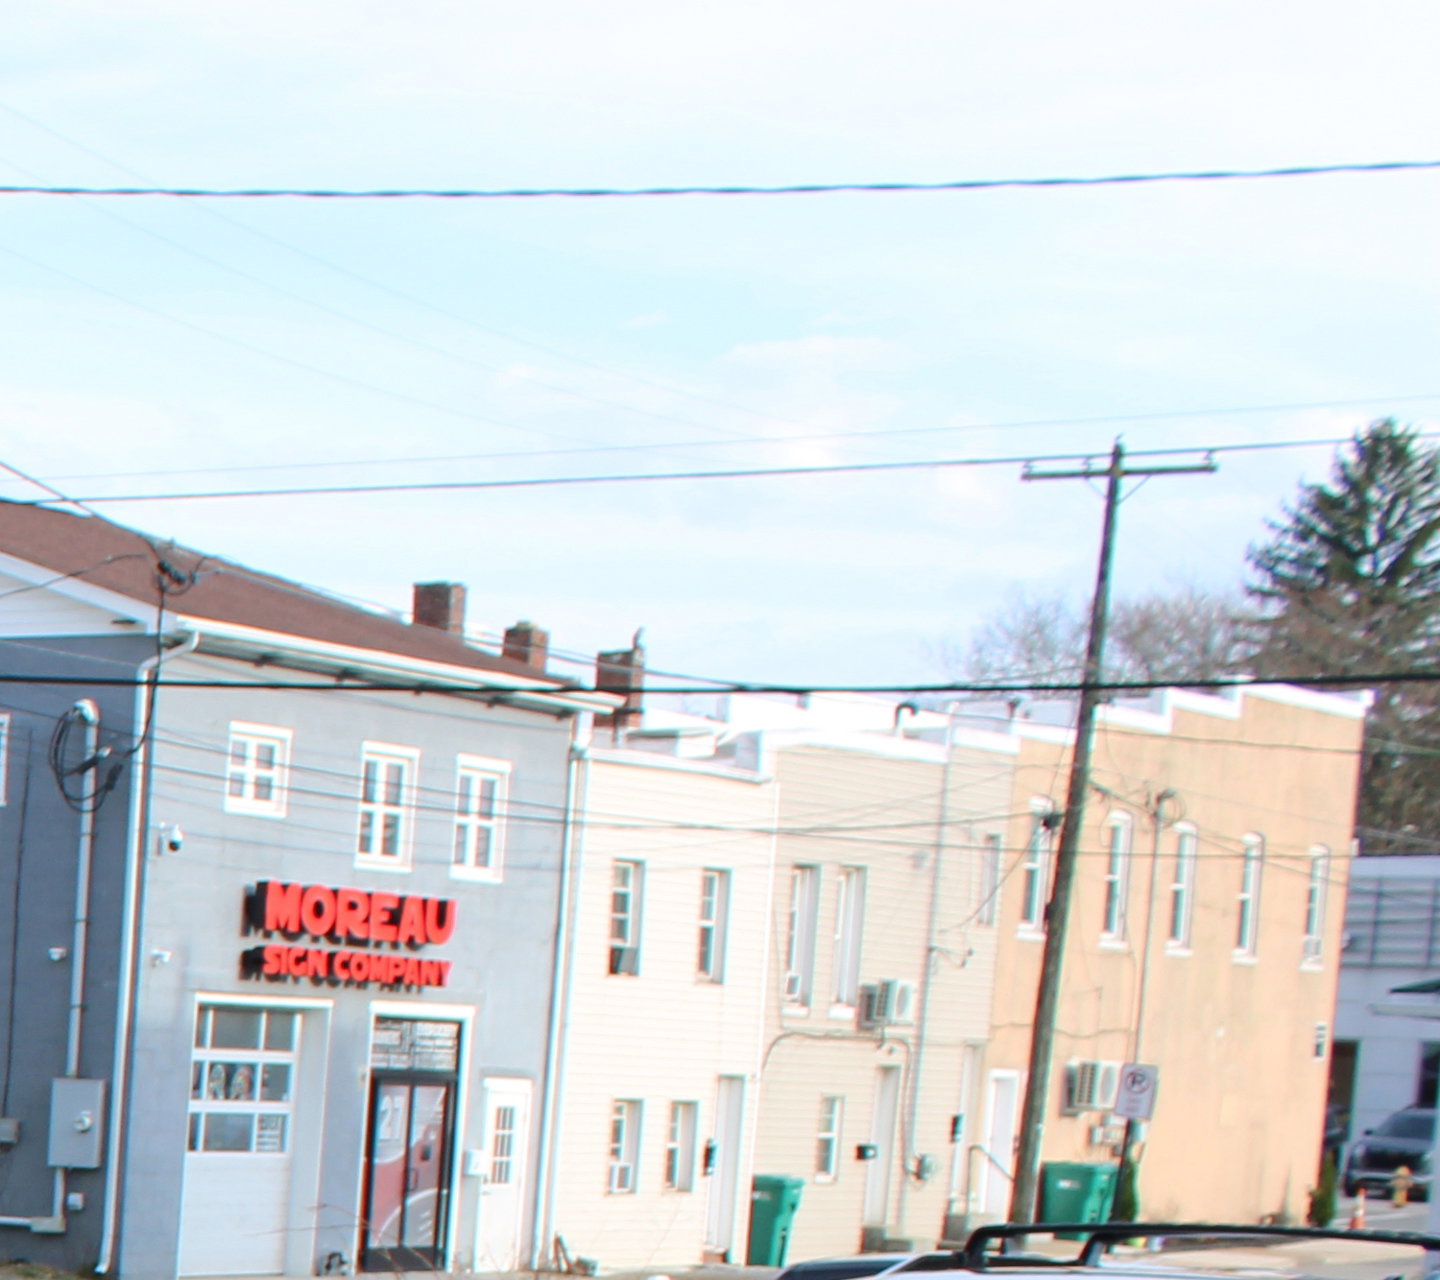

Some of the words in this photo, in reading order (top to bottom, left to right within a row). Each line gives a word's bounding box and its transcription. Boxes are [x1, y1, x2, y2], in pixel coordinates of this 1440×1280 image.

[264, 879, 458, 946] MOREAU
[262, 944, 329, 978] SIGN
[333, 950, 454, 988] COMPANY
